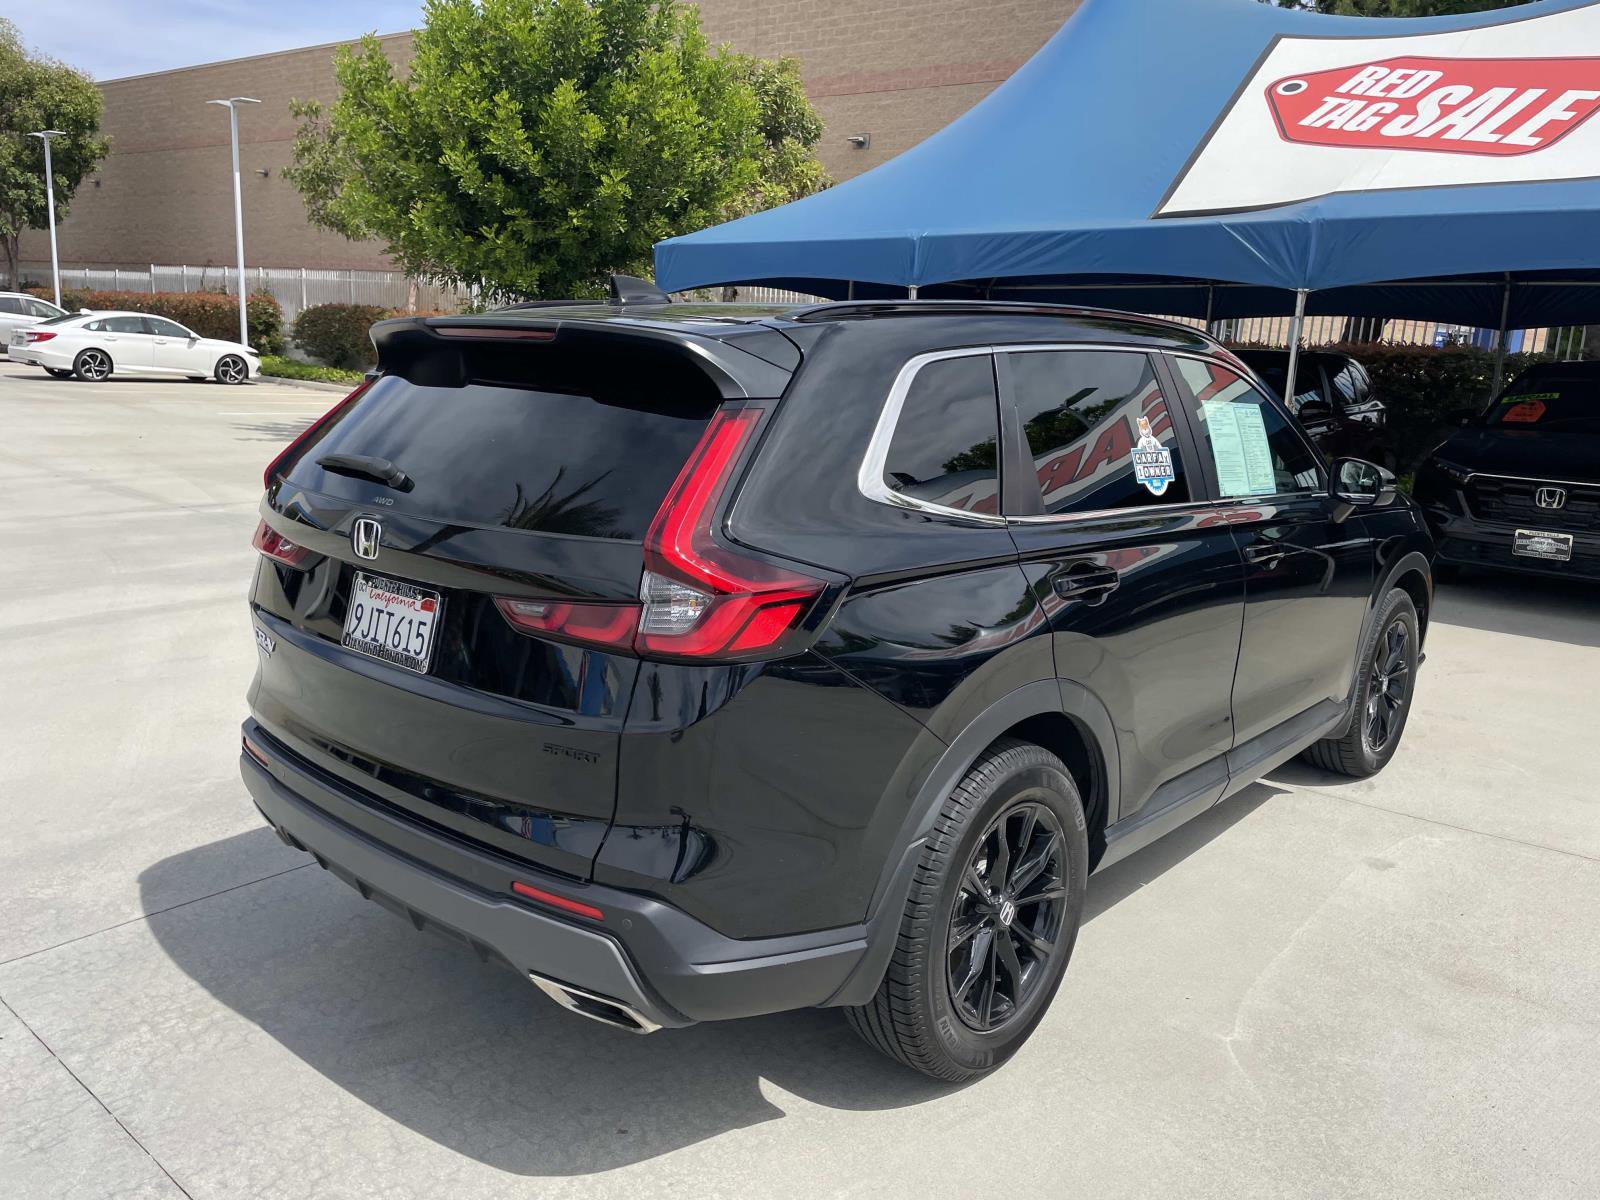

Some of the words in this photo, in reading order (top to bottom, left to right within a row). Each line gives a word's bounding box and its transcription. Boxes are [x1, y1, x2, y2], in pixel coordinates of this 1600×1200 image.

[1334, 65, 1444, 99] RED
[1297, 95, 1400, 132] TAG
[1379, 84, 1600, 147] SALE
[1135, 451, 1170, 465] CARFAX
[369, 588, 421, 611] California
[352, 603, 427, 657] 9JIT615
